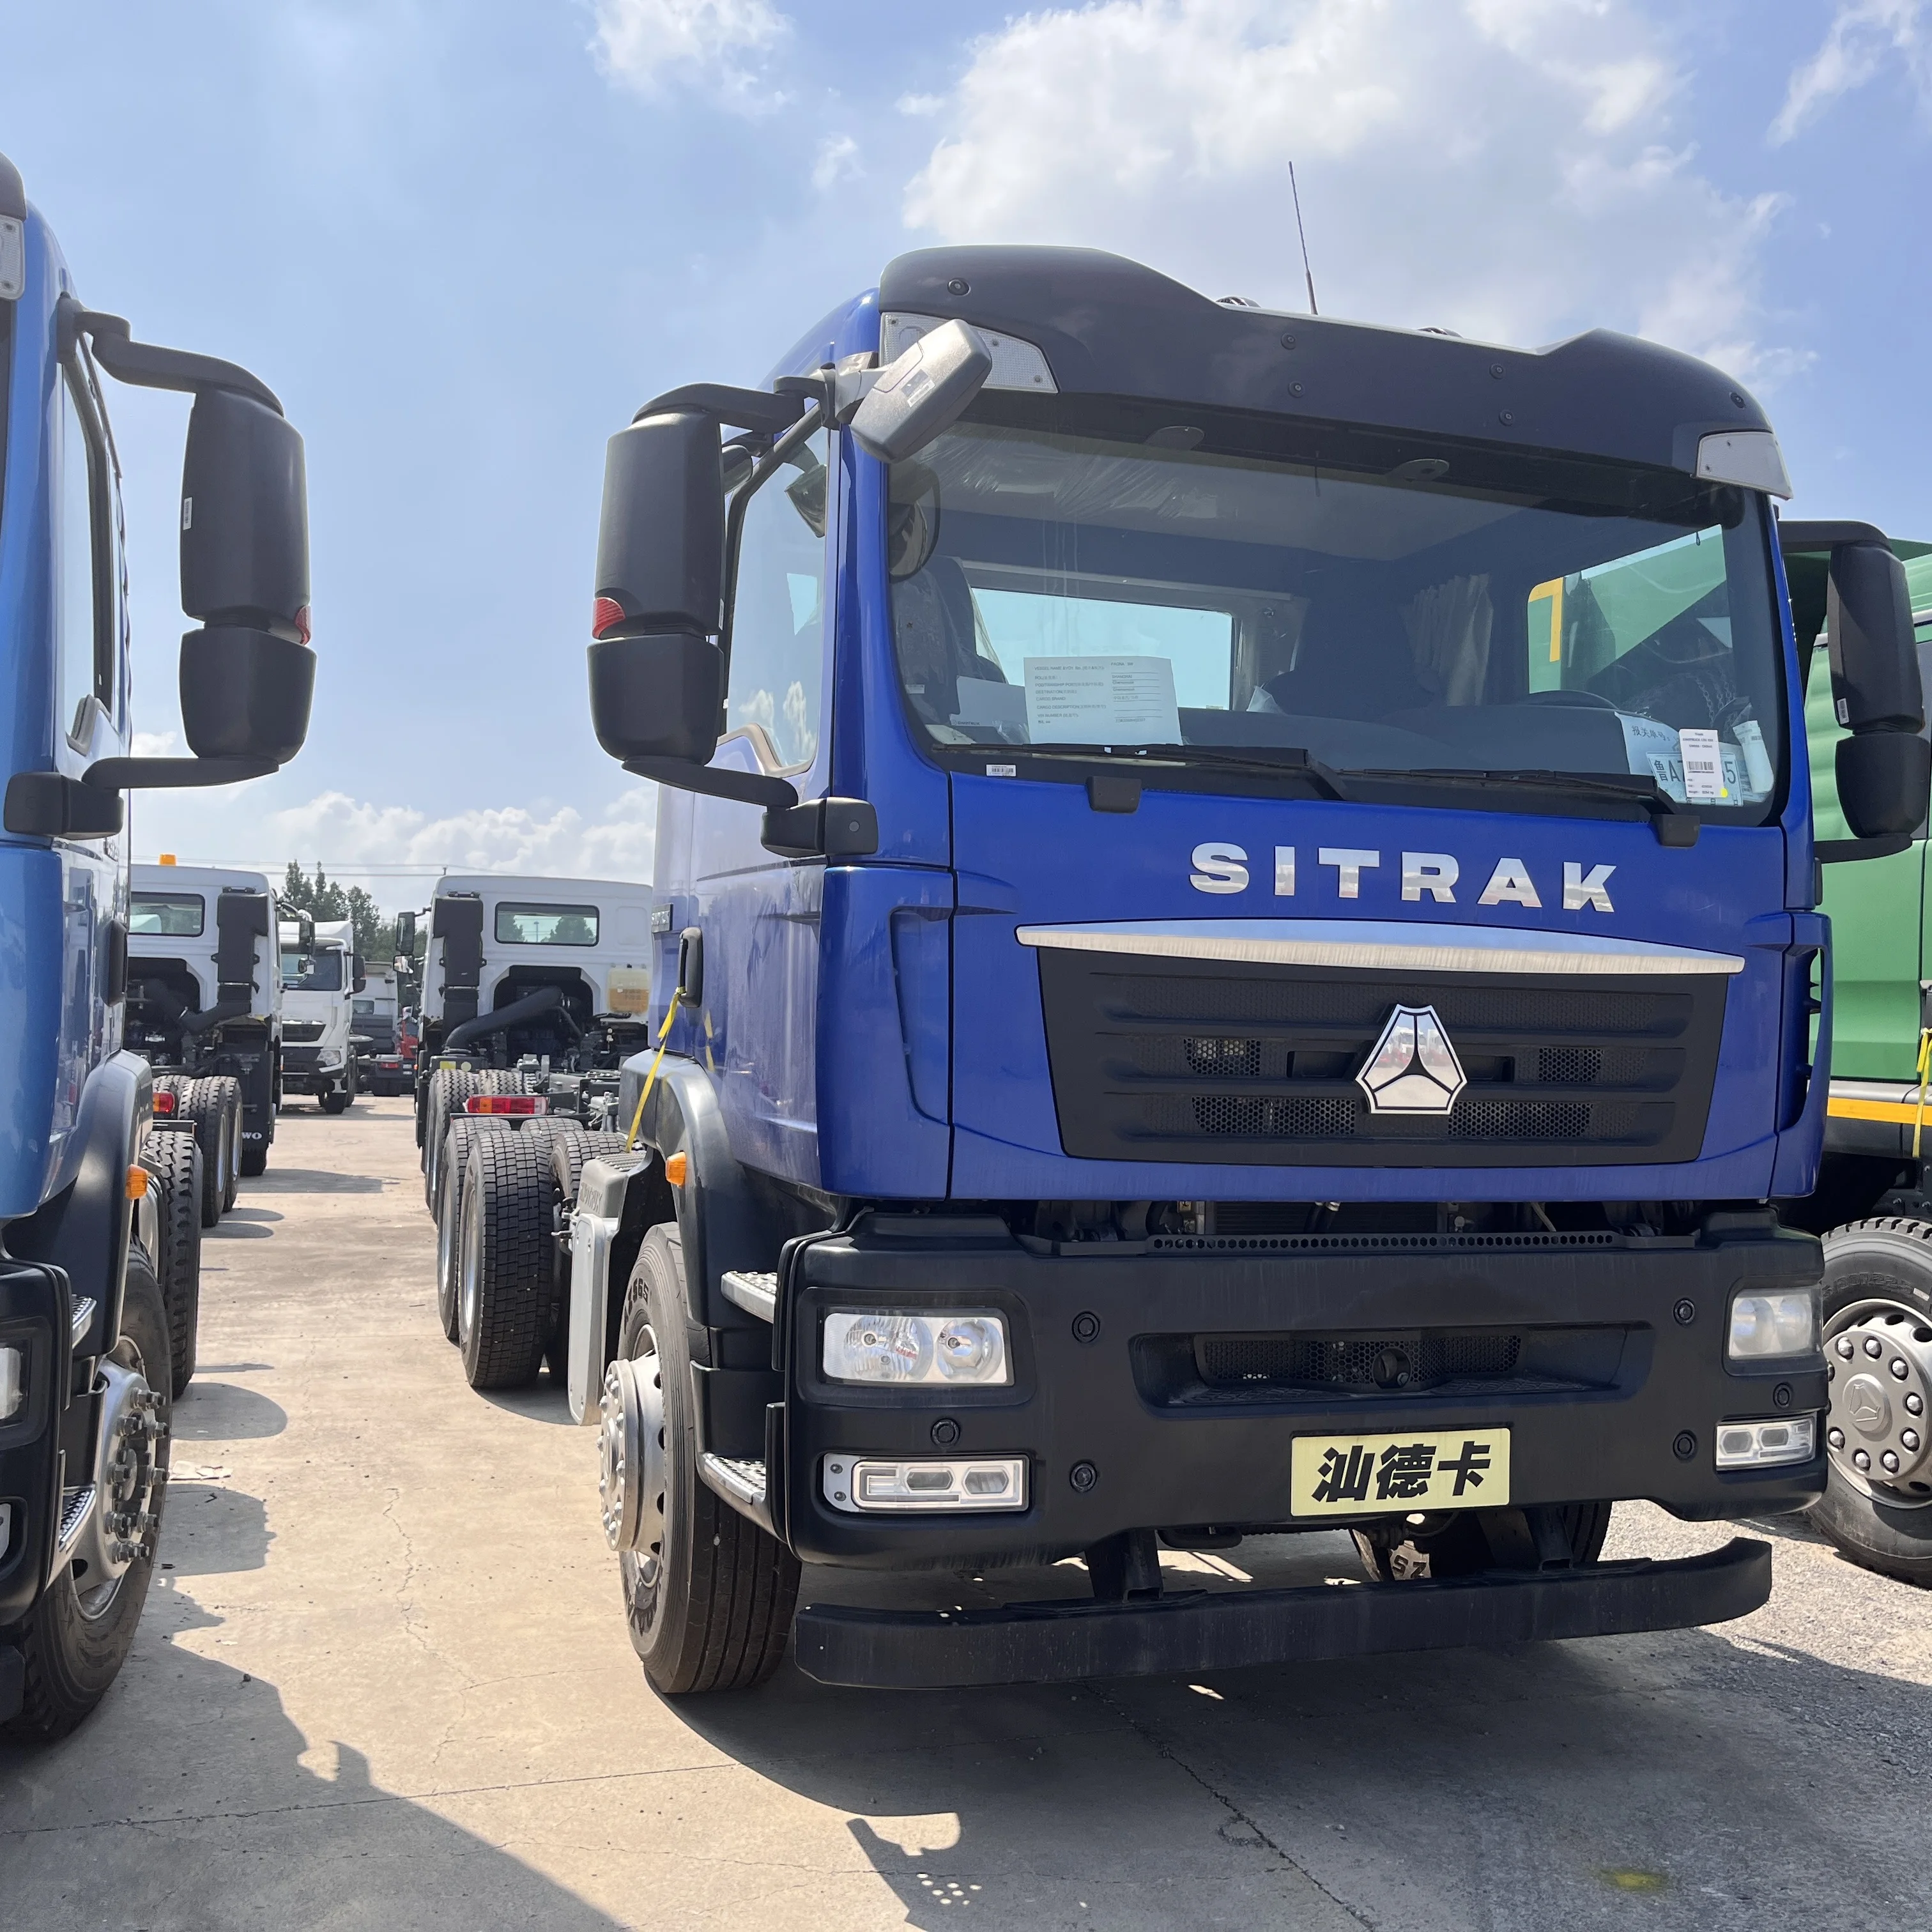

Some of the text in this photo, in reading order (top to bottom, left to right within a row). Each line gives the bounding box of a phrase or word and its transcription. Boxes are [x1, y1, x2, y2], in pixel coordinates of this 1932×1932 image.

[1188, 841, 1616, 913] SITRAK
[1311, 1441, 1491, 1503] 汕德卡
